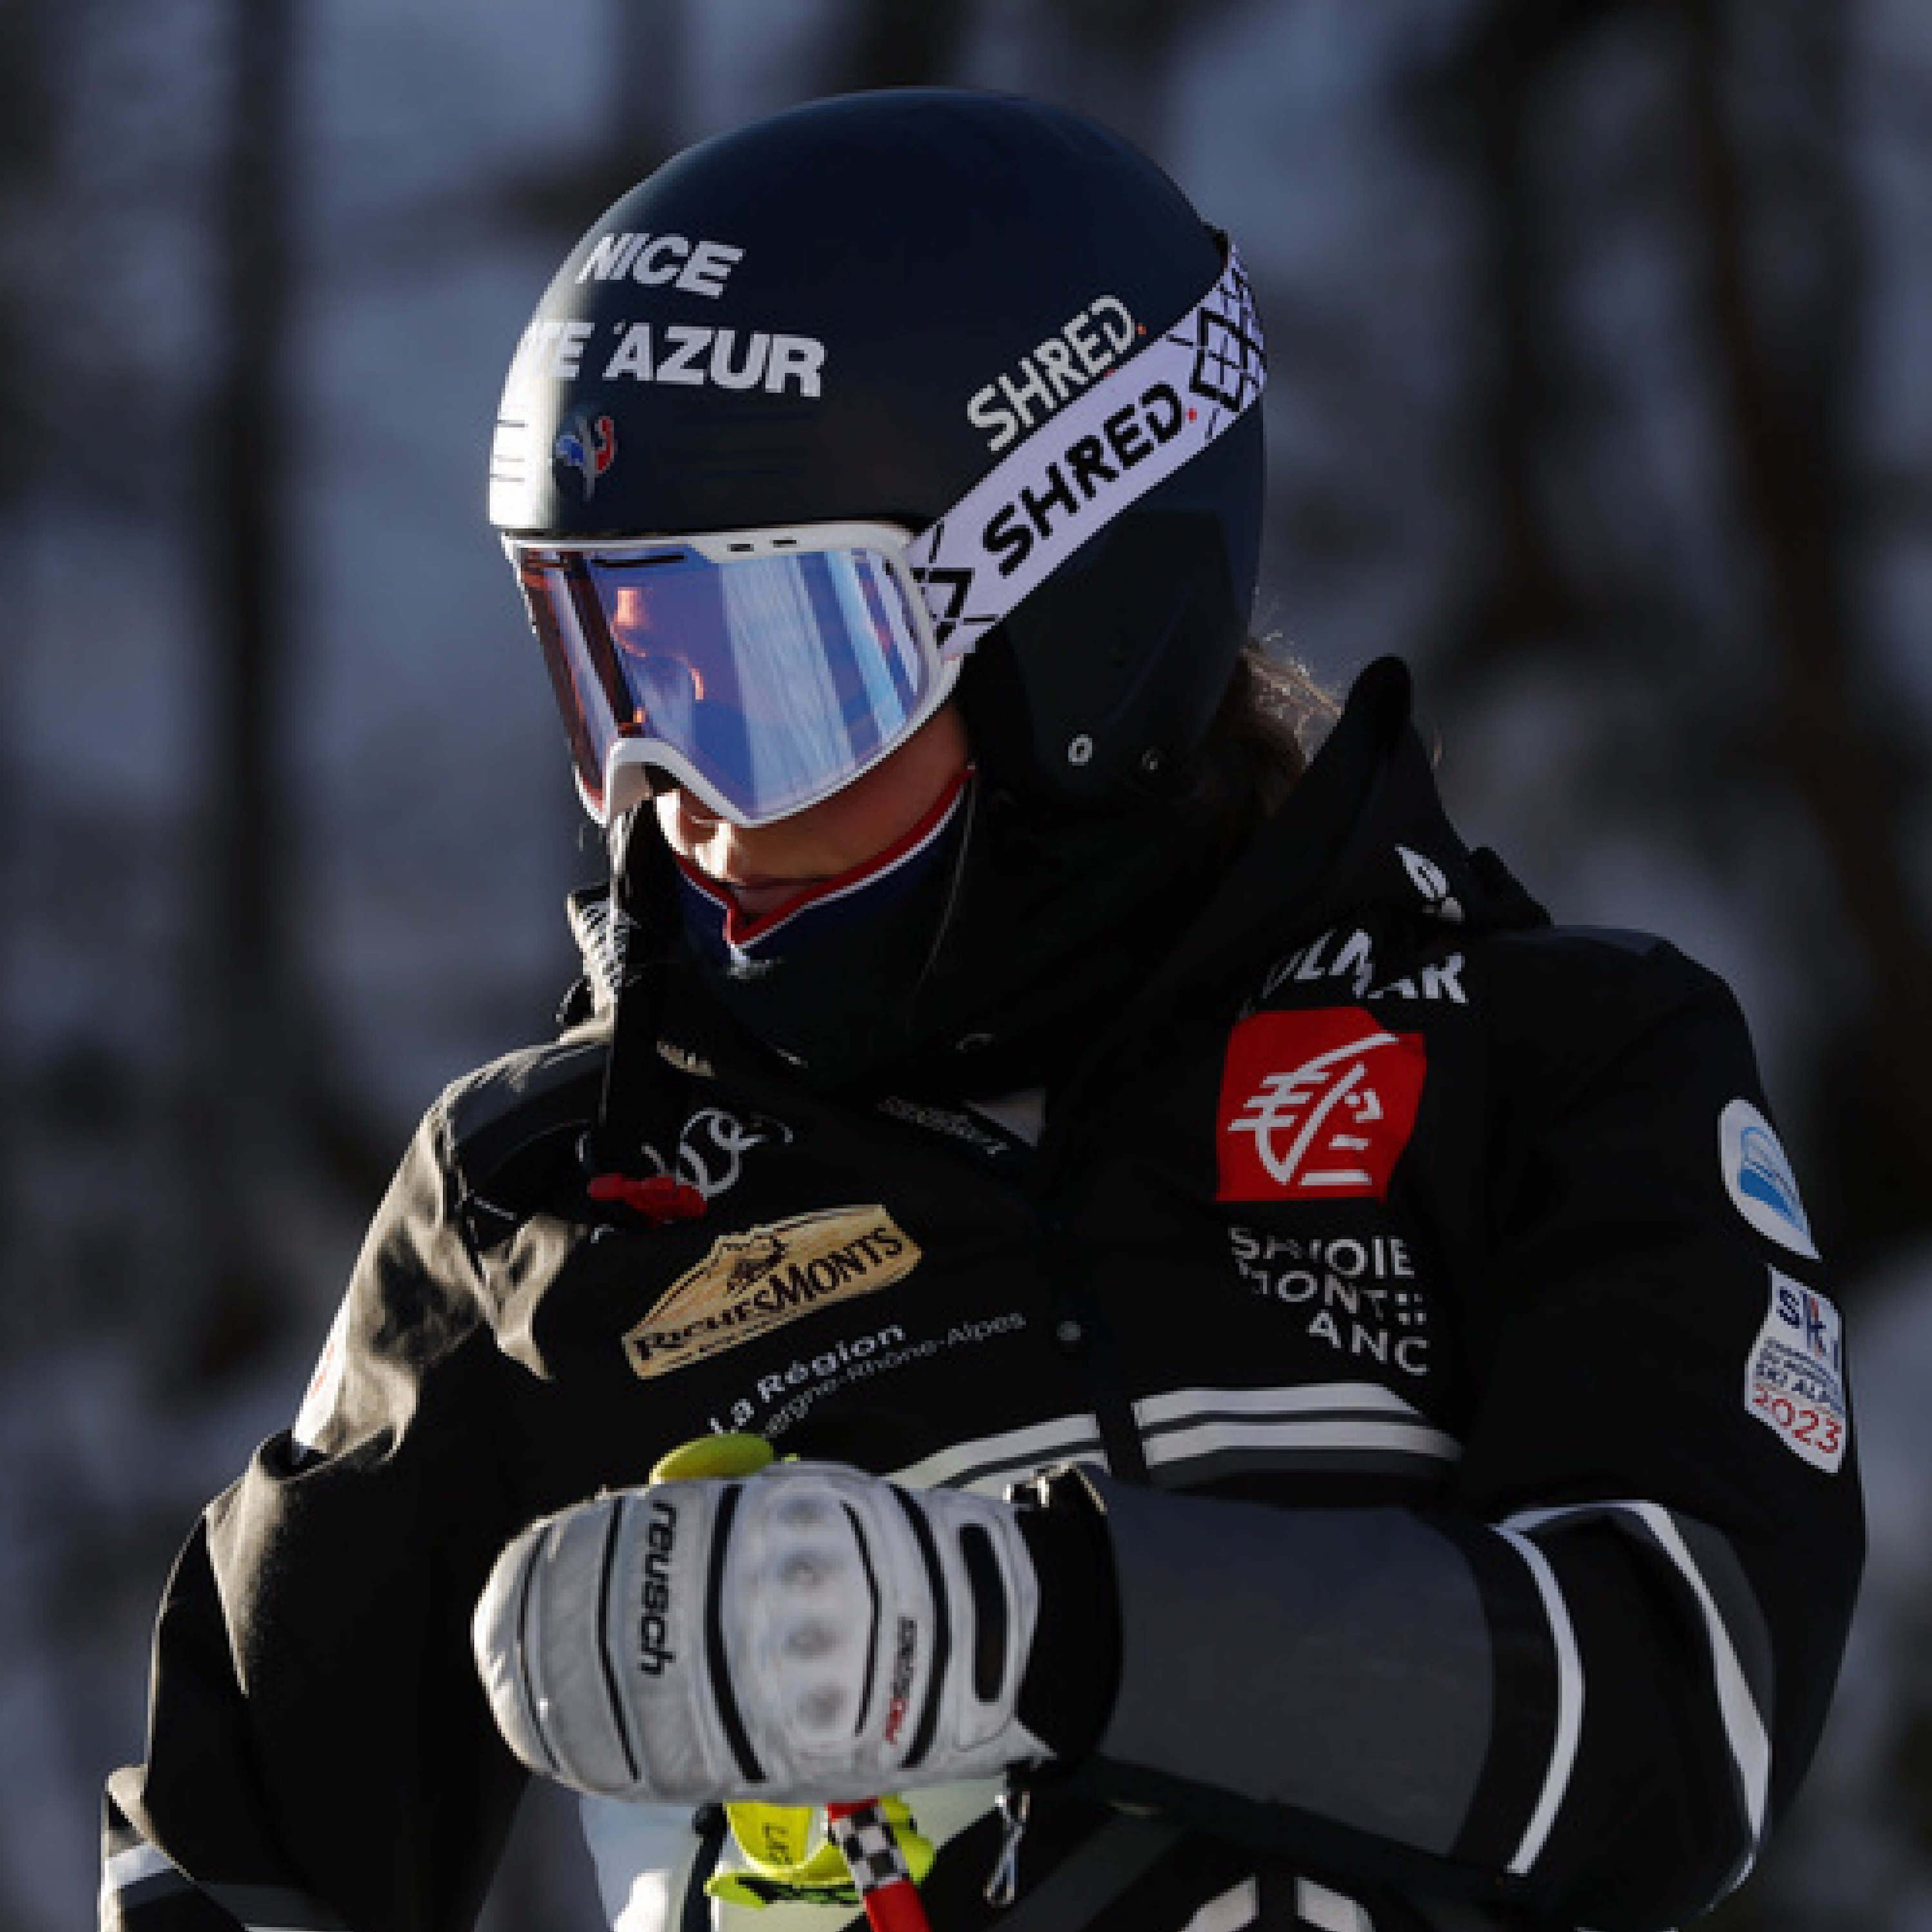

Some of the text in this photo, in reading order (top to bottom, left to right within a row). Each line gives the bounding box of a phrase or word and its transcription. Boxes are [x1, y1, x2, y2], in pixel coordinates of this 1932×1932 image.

[576, 232, 746, 299] NICE
[1306, 1309, 1428, 1376] ANC
[708, 1323, 907, 1436] La Région
[1752, 1382, 1842, 1455] 2023
[639, 1499, 677, 1678] reusch
